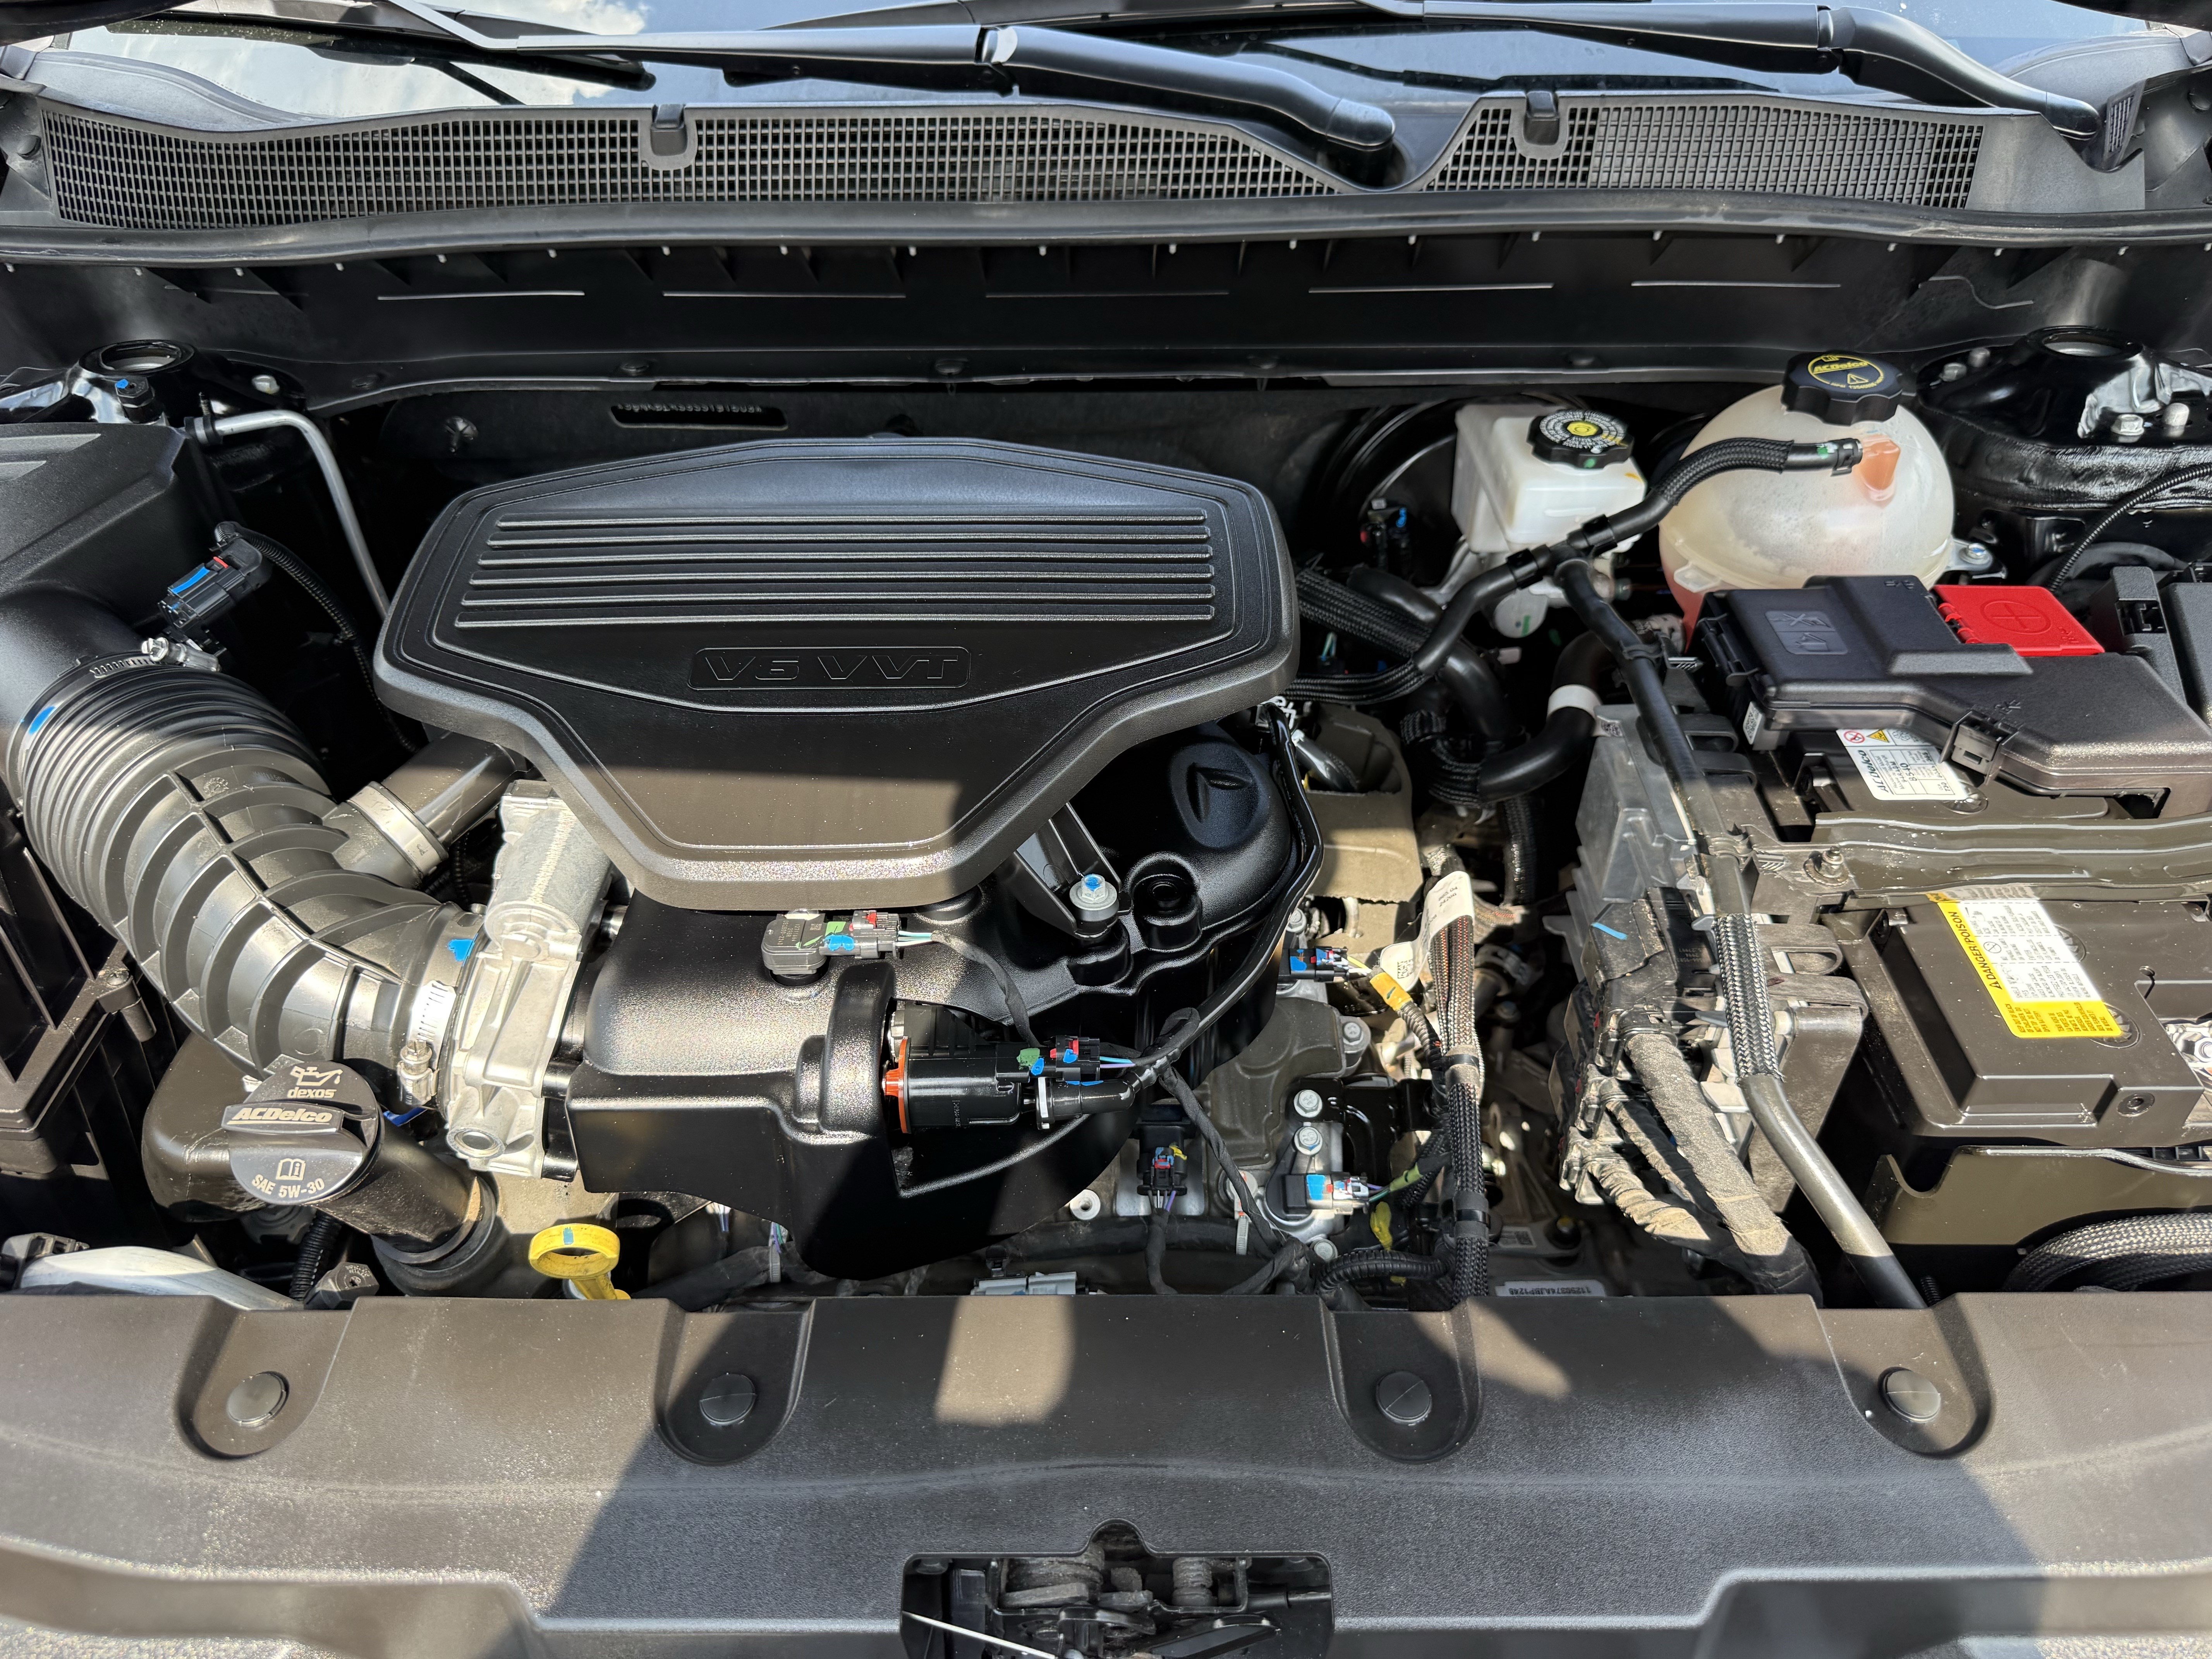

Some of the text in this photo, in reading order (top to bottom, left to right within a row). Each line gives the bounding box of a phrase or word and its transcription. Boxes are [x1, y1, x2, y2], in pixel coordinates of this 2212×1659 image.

[1814, 362, 1869, 372] ACDelco
[705, 655, 958, 680] V6 VVT
[1948, 911, 1997, 979] DANGER/POISON
[287, 1087, 337, 1099] dexos
[232, 1107, 333, 1123] ACDelco
[252, 1174, 325, 1198] SAE 5W-30
